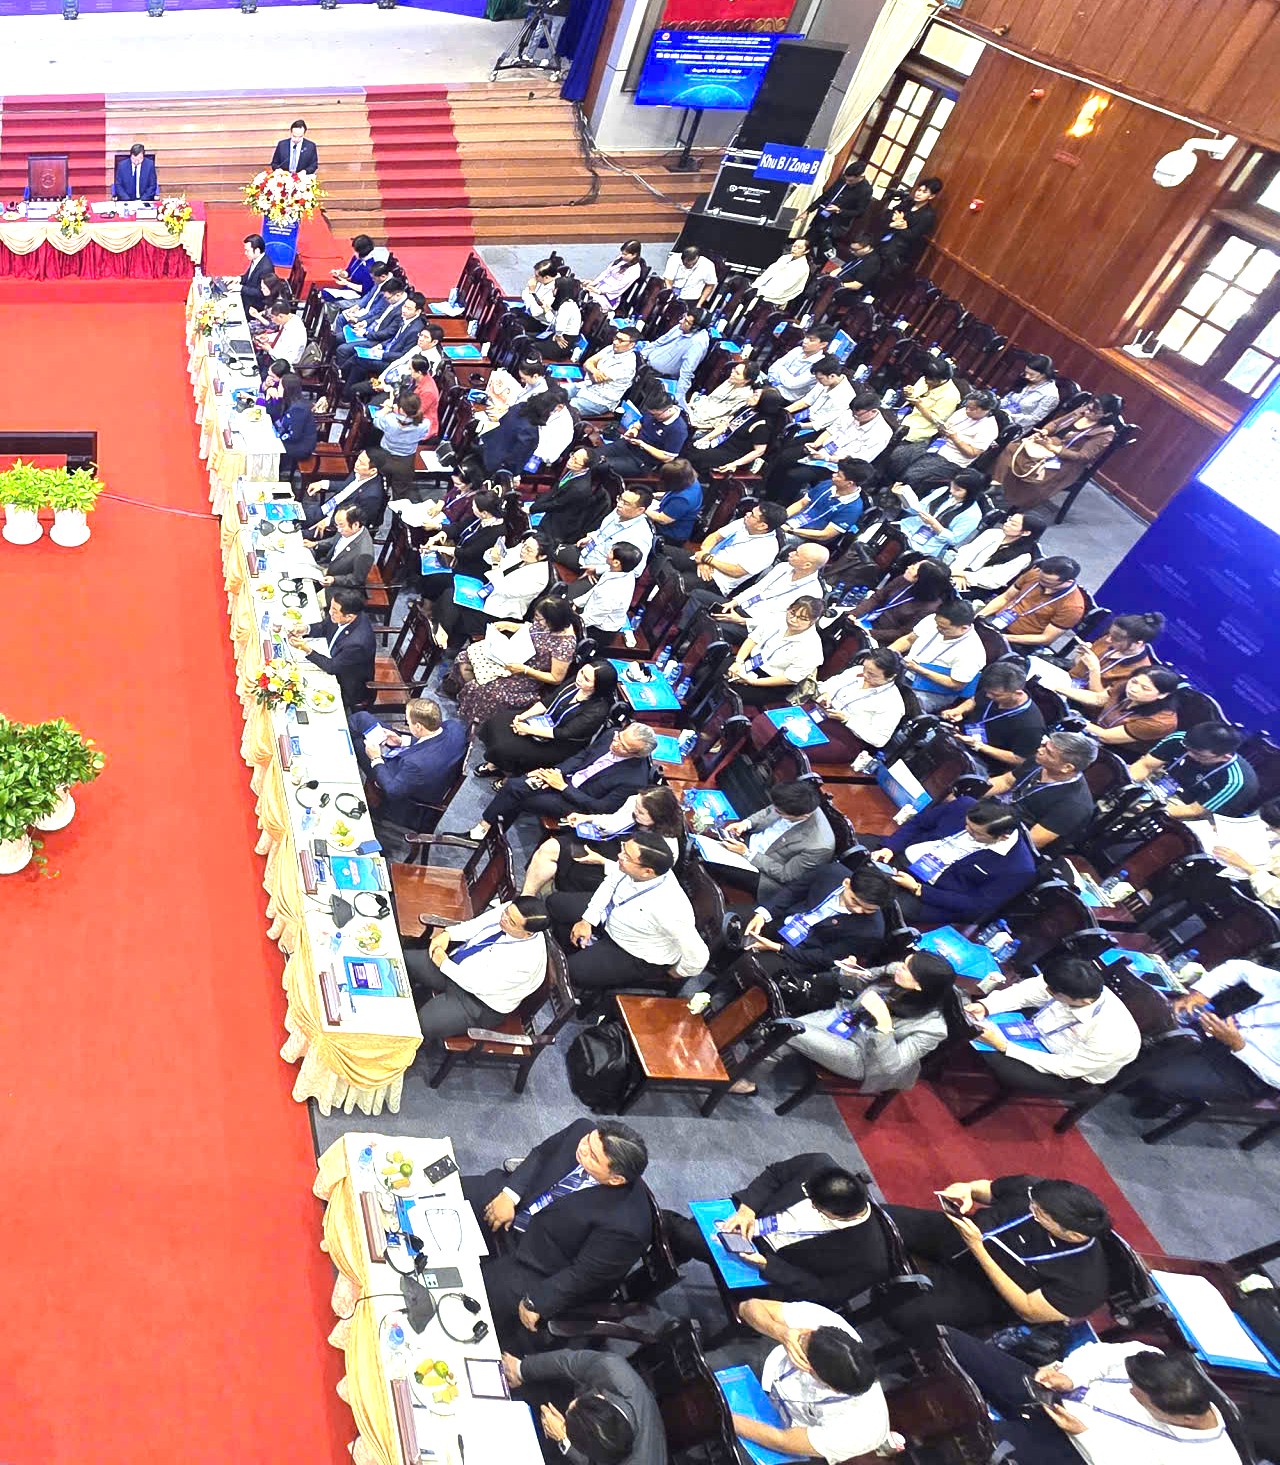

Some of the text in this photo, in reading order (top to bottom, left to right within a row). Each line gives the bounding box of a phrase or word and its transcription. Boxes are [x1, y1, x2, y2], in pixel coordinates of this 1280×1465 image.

[760, 153, 778, 169] Khu
[776, 156, 787, 170] B
[788, 157, 811, 174] Zone
[809, 160, 820, 175] B
